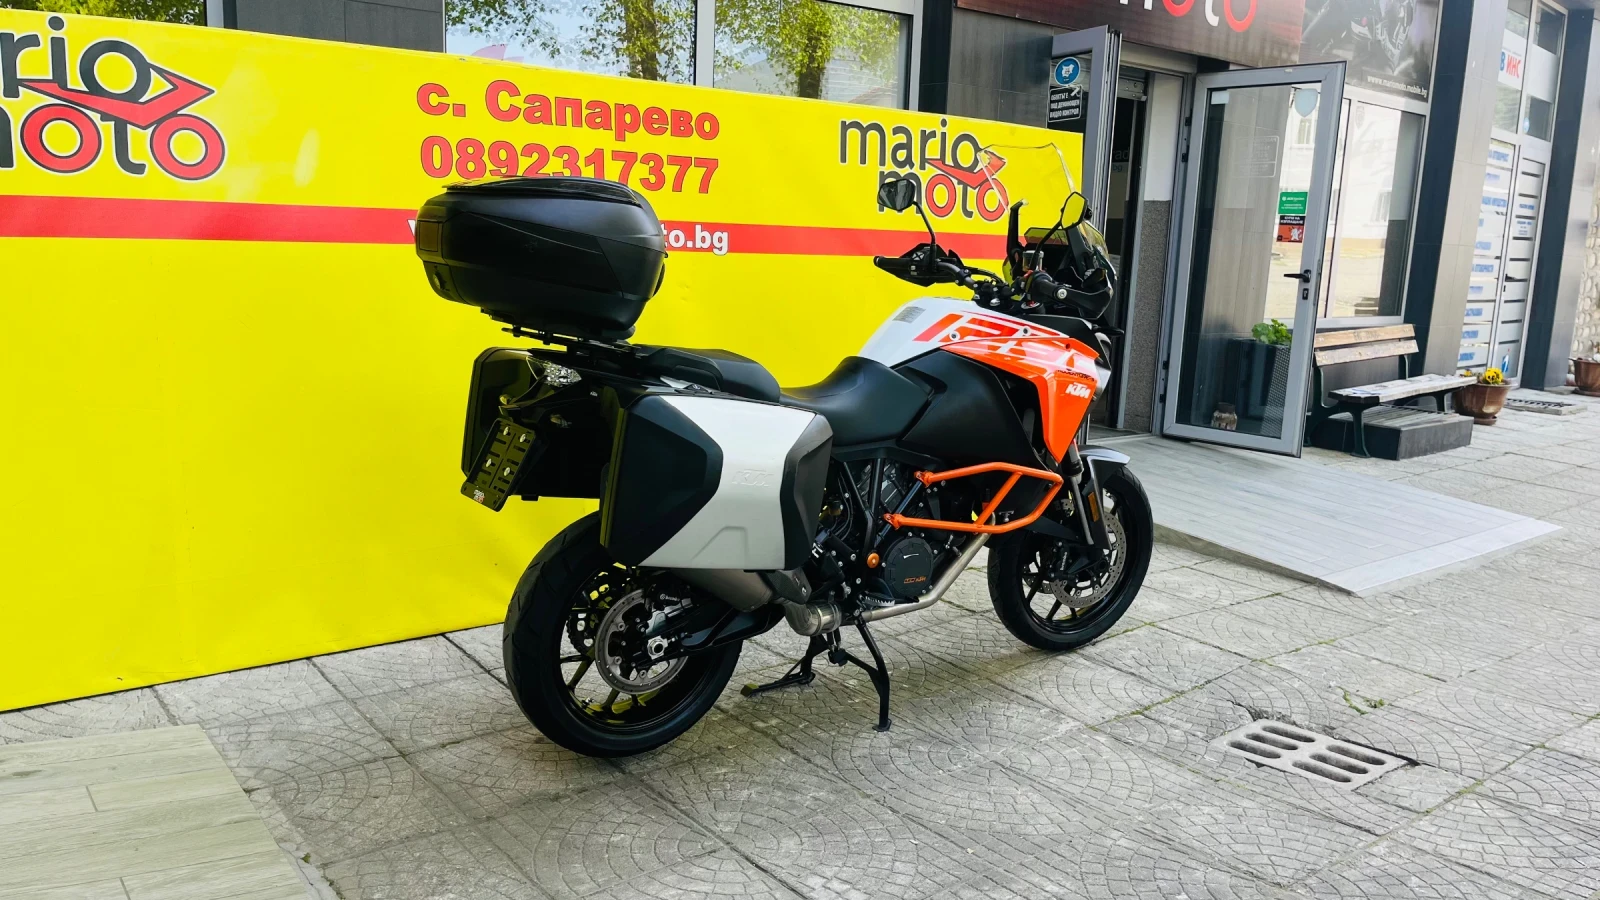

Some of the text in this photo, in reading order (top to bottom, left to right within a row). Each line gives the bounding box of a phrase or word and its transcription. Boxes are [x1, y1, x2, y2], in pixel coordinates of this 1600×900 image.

[1506, 55, 1522, 79] ИНС
[416, 79, 720, 142] с. Сапарево
[420, 135, 719, 195] 0892317377
[840, 118, 982, 174] mario
[1065, 382, 1091, 398] KTM
